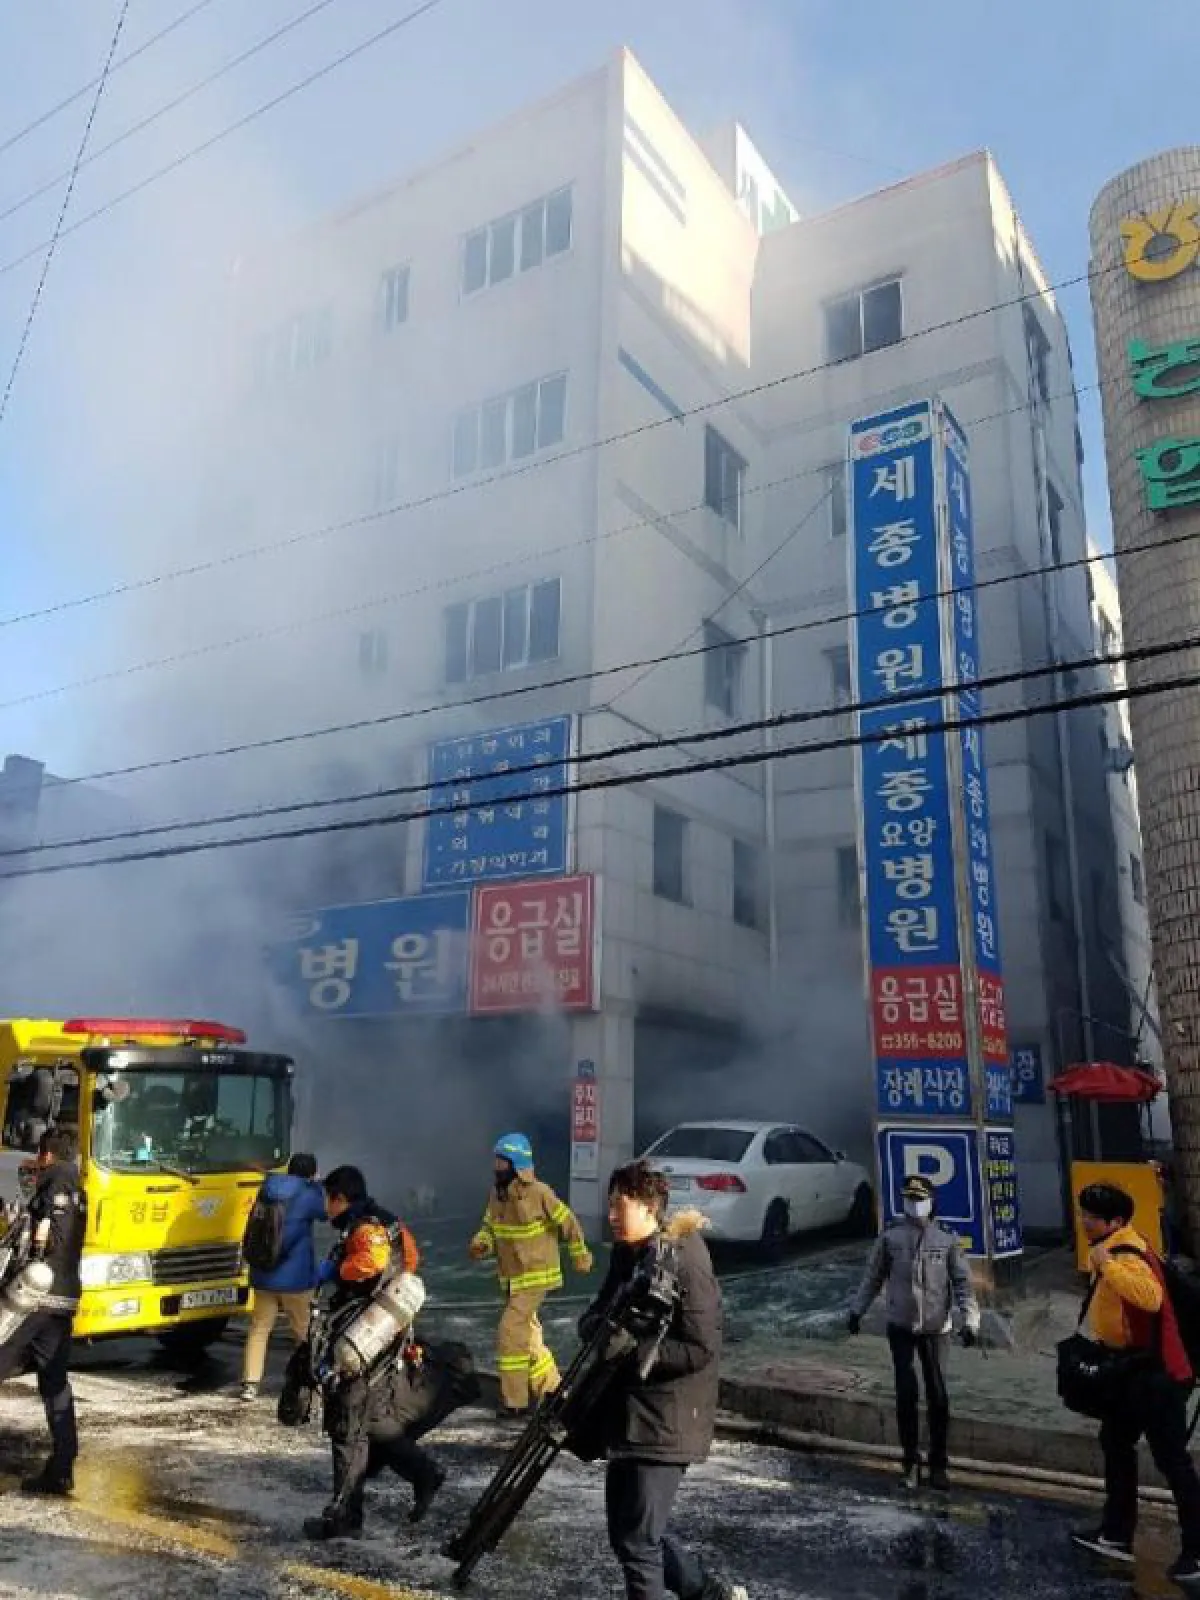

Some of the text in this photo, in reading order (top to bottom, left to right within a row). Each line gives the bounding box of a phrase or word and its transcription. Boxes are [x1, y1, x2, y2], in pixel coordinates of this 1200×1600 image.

[486, 893, 583, 962] 응급실
[298, 930, 460, 1010] 병원
[879, 974, 959, 1024] 응급실
[883, 1067, 965, 1108] 장례식장
[903, 1144, 955, 1188] P
